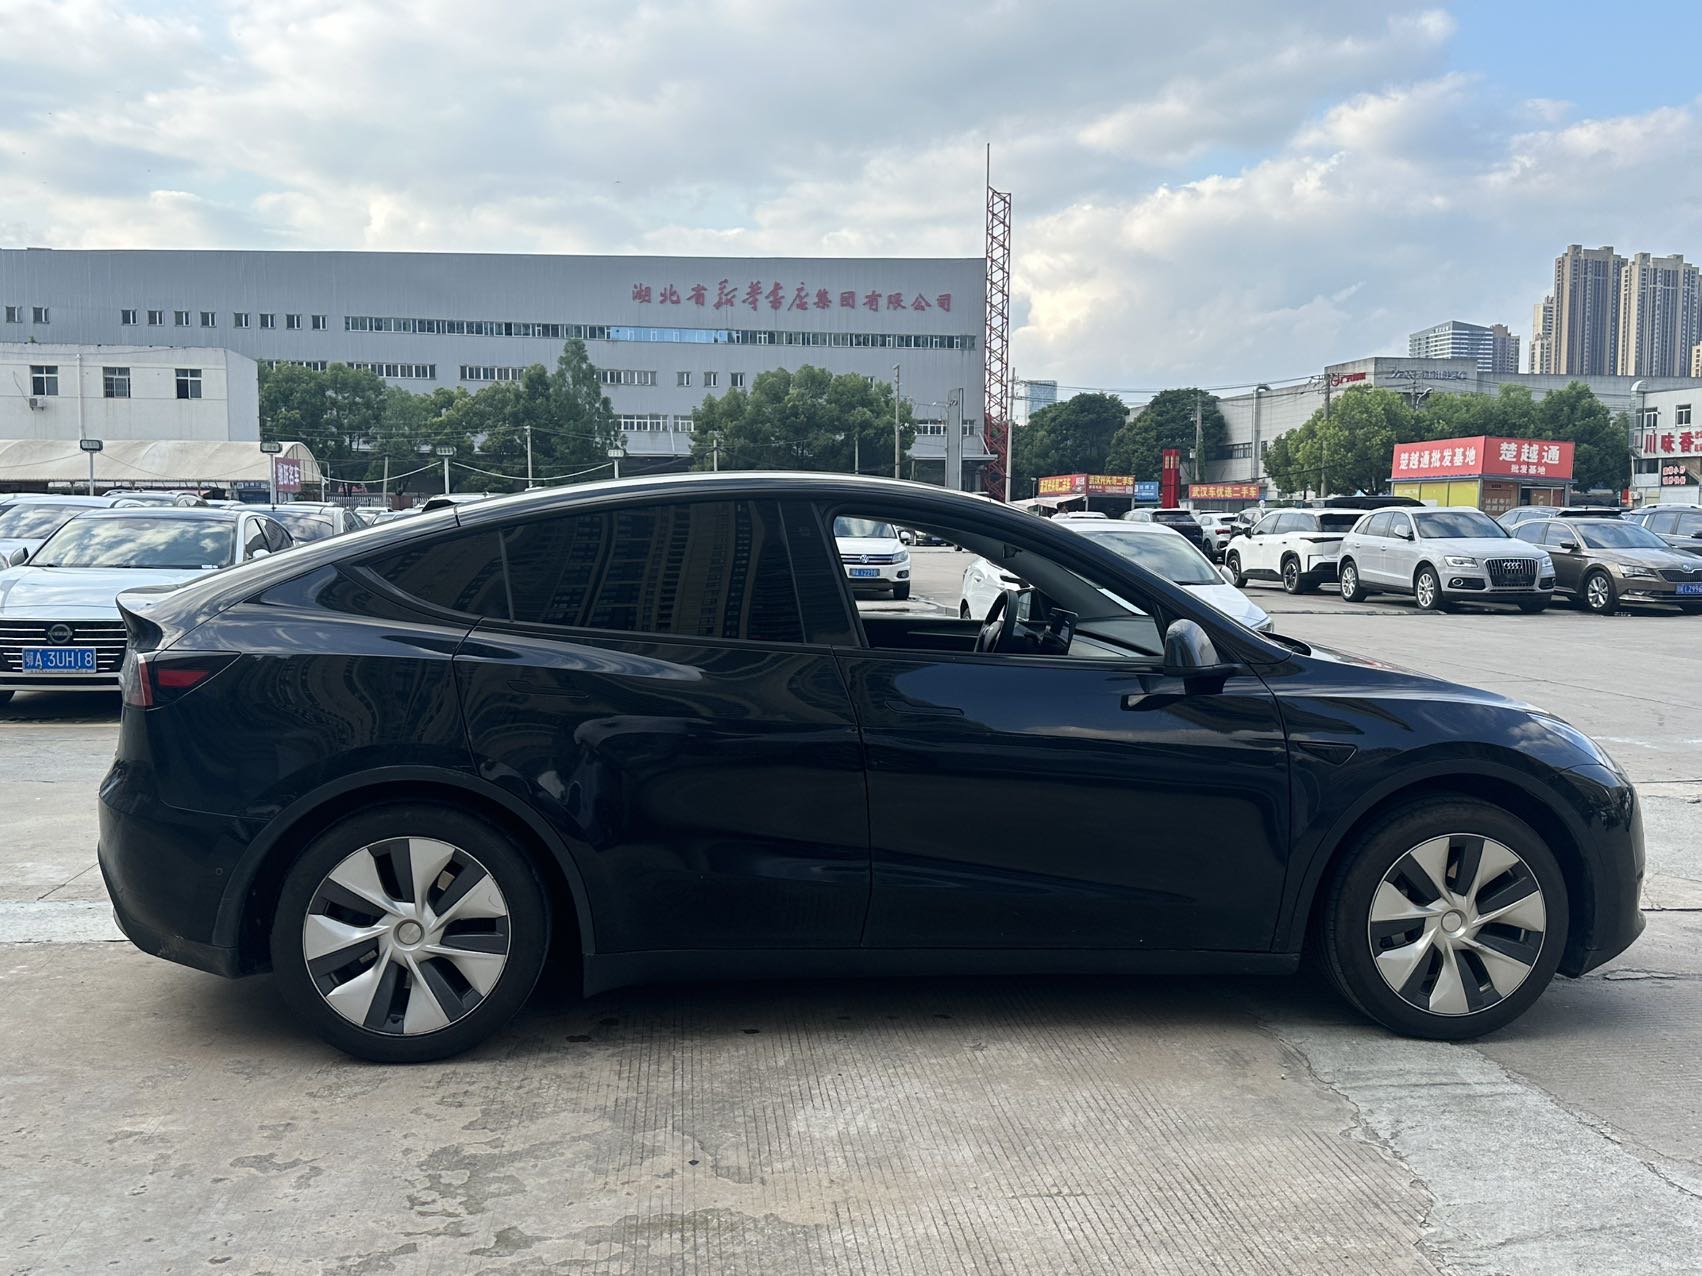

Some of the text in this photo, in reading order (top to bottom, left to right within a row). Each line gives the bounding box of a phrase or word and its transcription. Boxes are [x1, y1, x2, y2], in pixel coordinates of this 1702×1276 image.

[1399, 447, 1477, 470] 楚越通批发基地
[1499, 442, 1560, 464] 楚越通
[1510, 464, 1546, 475] 批发基地
[1191, 486, 1257, 498] 武汉车优选二手车
